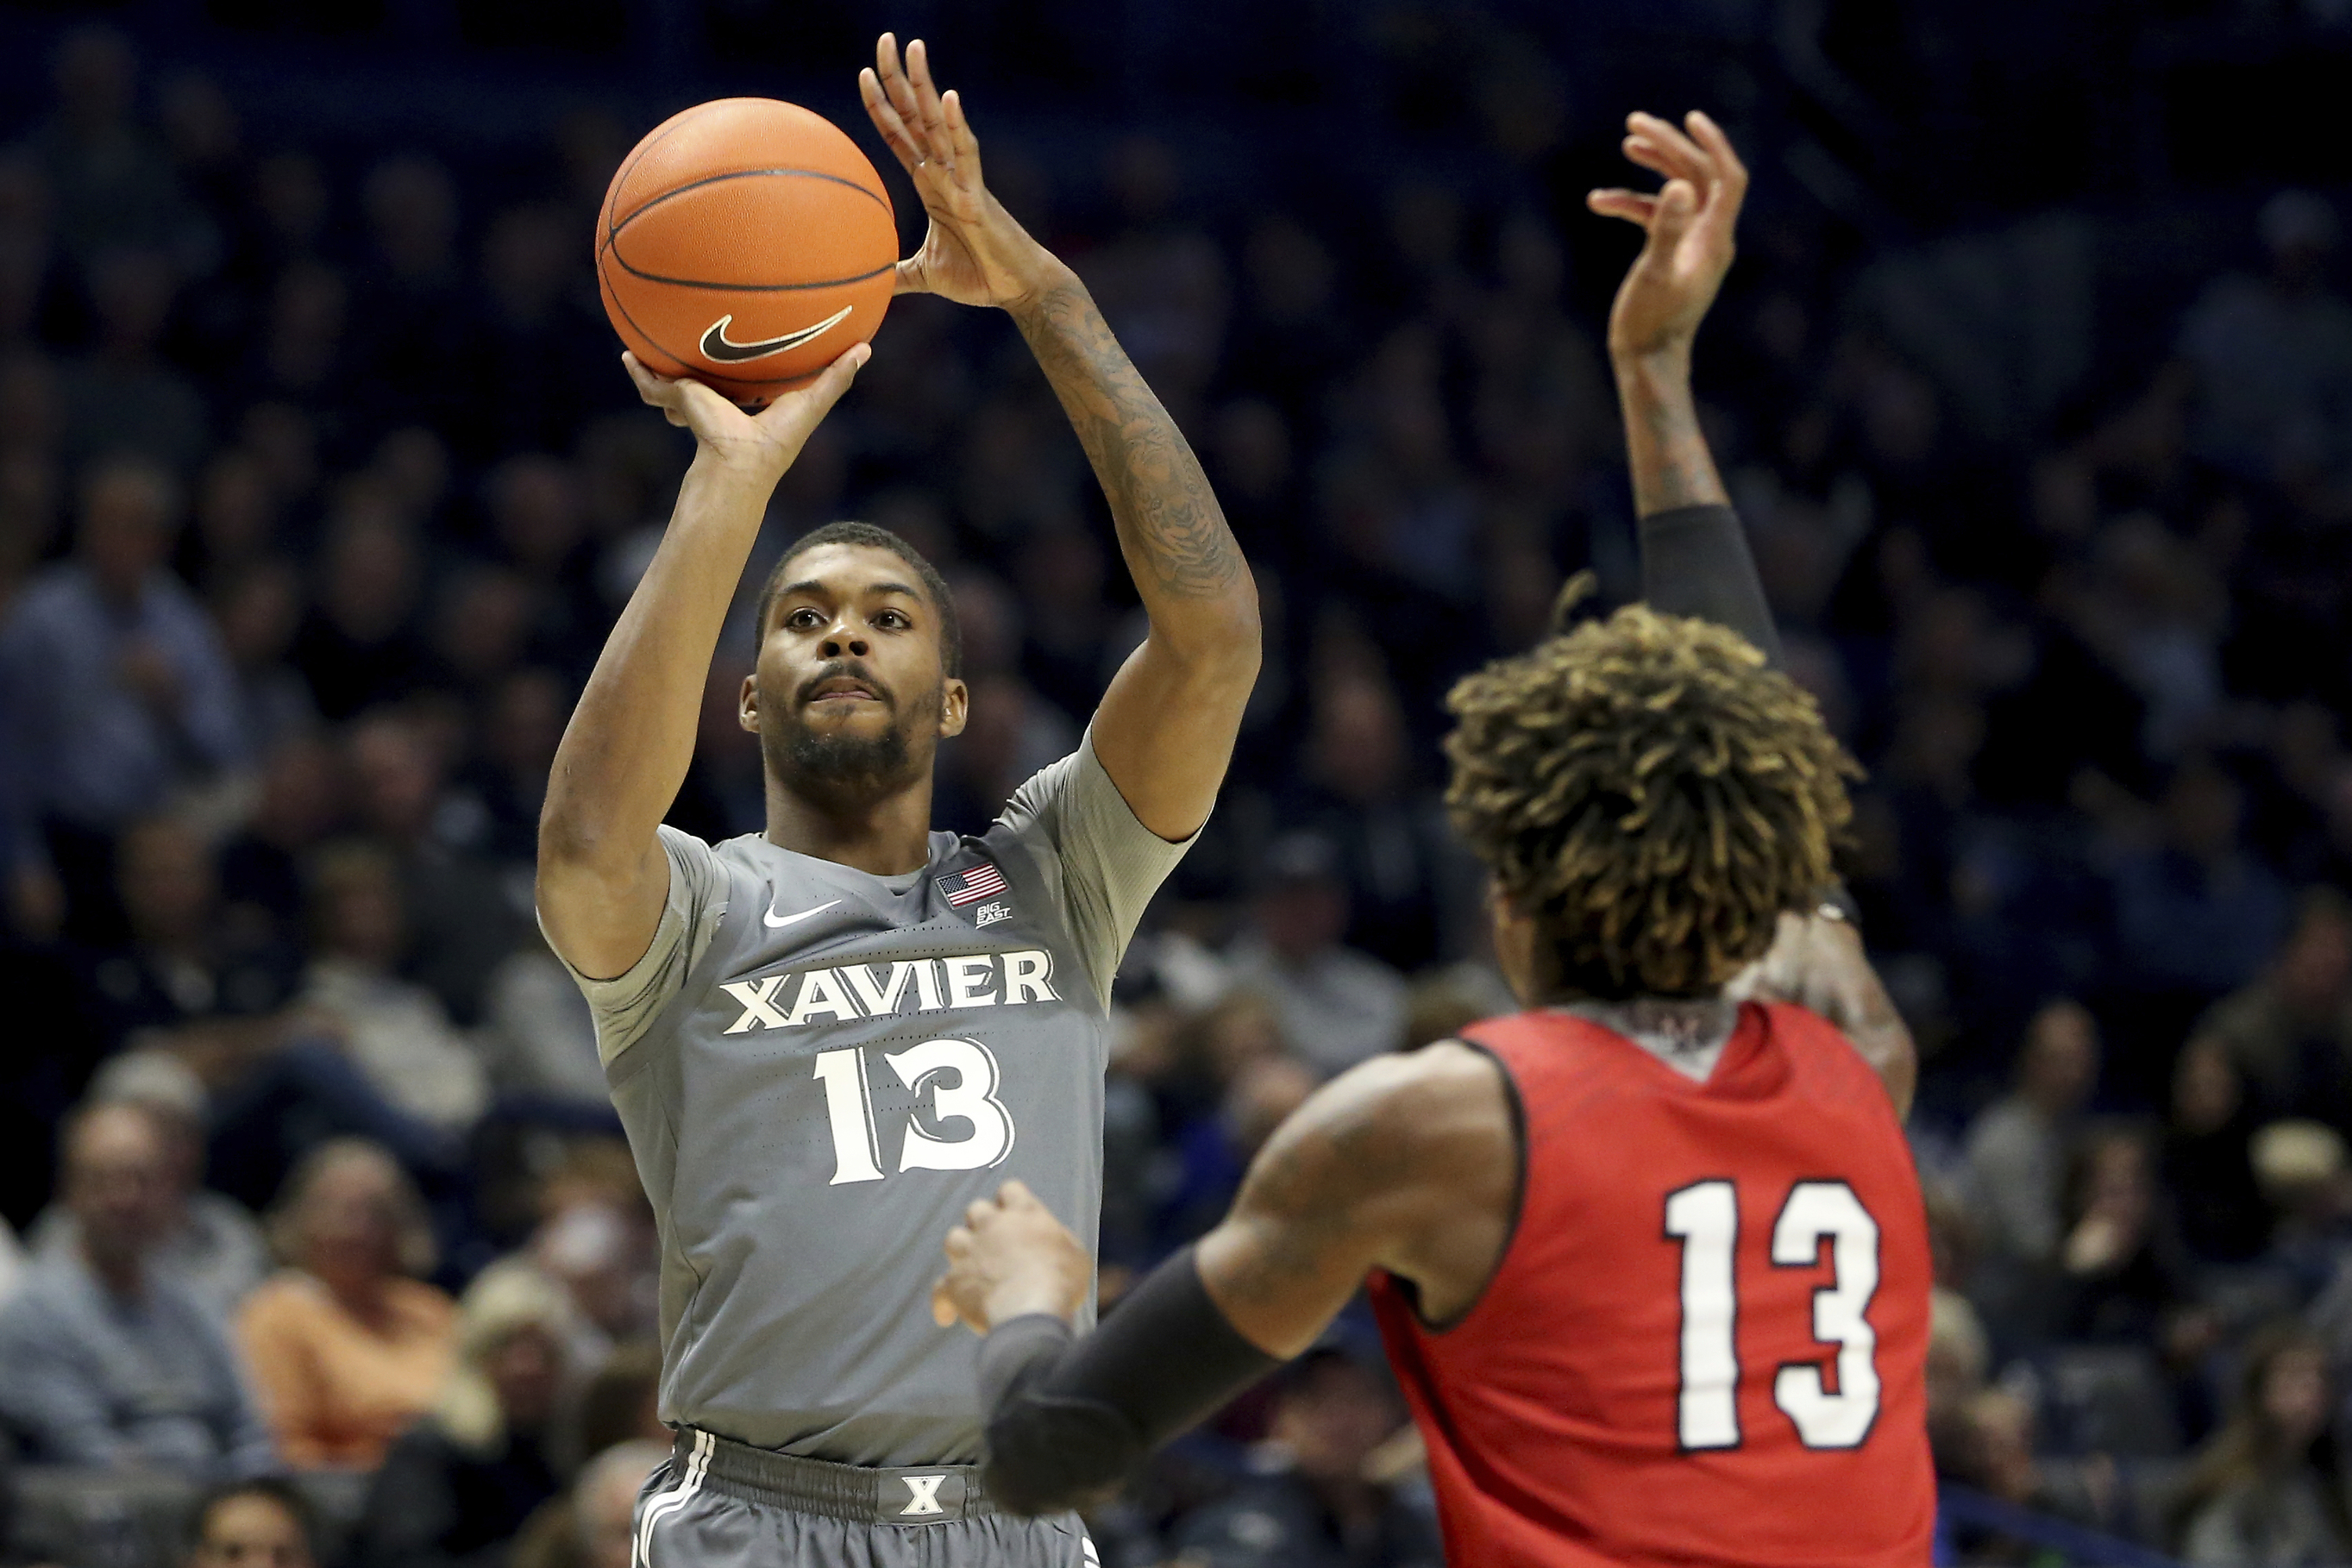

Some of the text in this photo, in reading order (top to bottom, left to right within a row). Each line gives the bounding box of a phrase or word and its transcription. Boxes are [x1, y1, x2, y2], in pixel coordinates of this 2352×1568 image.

[976, 901, 1000, 917] BIG
[976, 907, 1011, 925] EAST
[718, 949, 1063, 1034] XAVIER
[812, 1037, 1017, 1185] 13
[1664, 1178, 1882, 1454] 13
[899, 1474, 948, 1516] X
